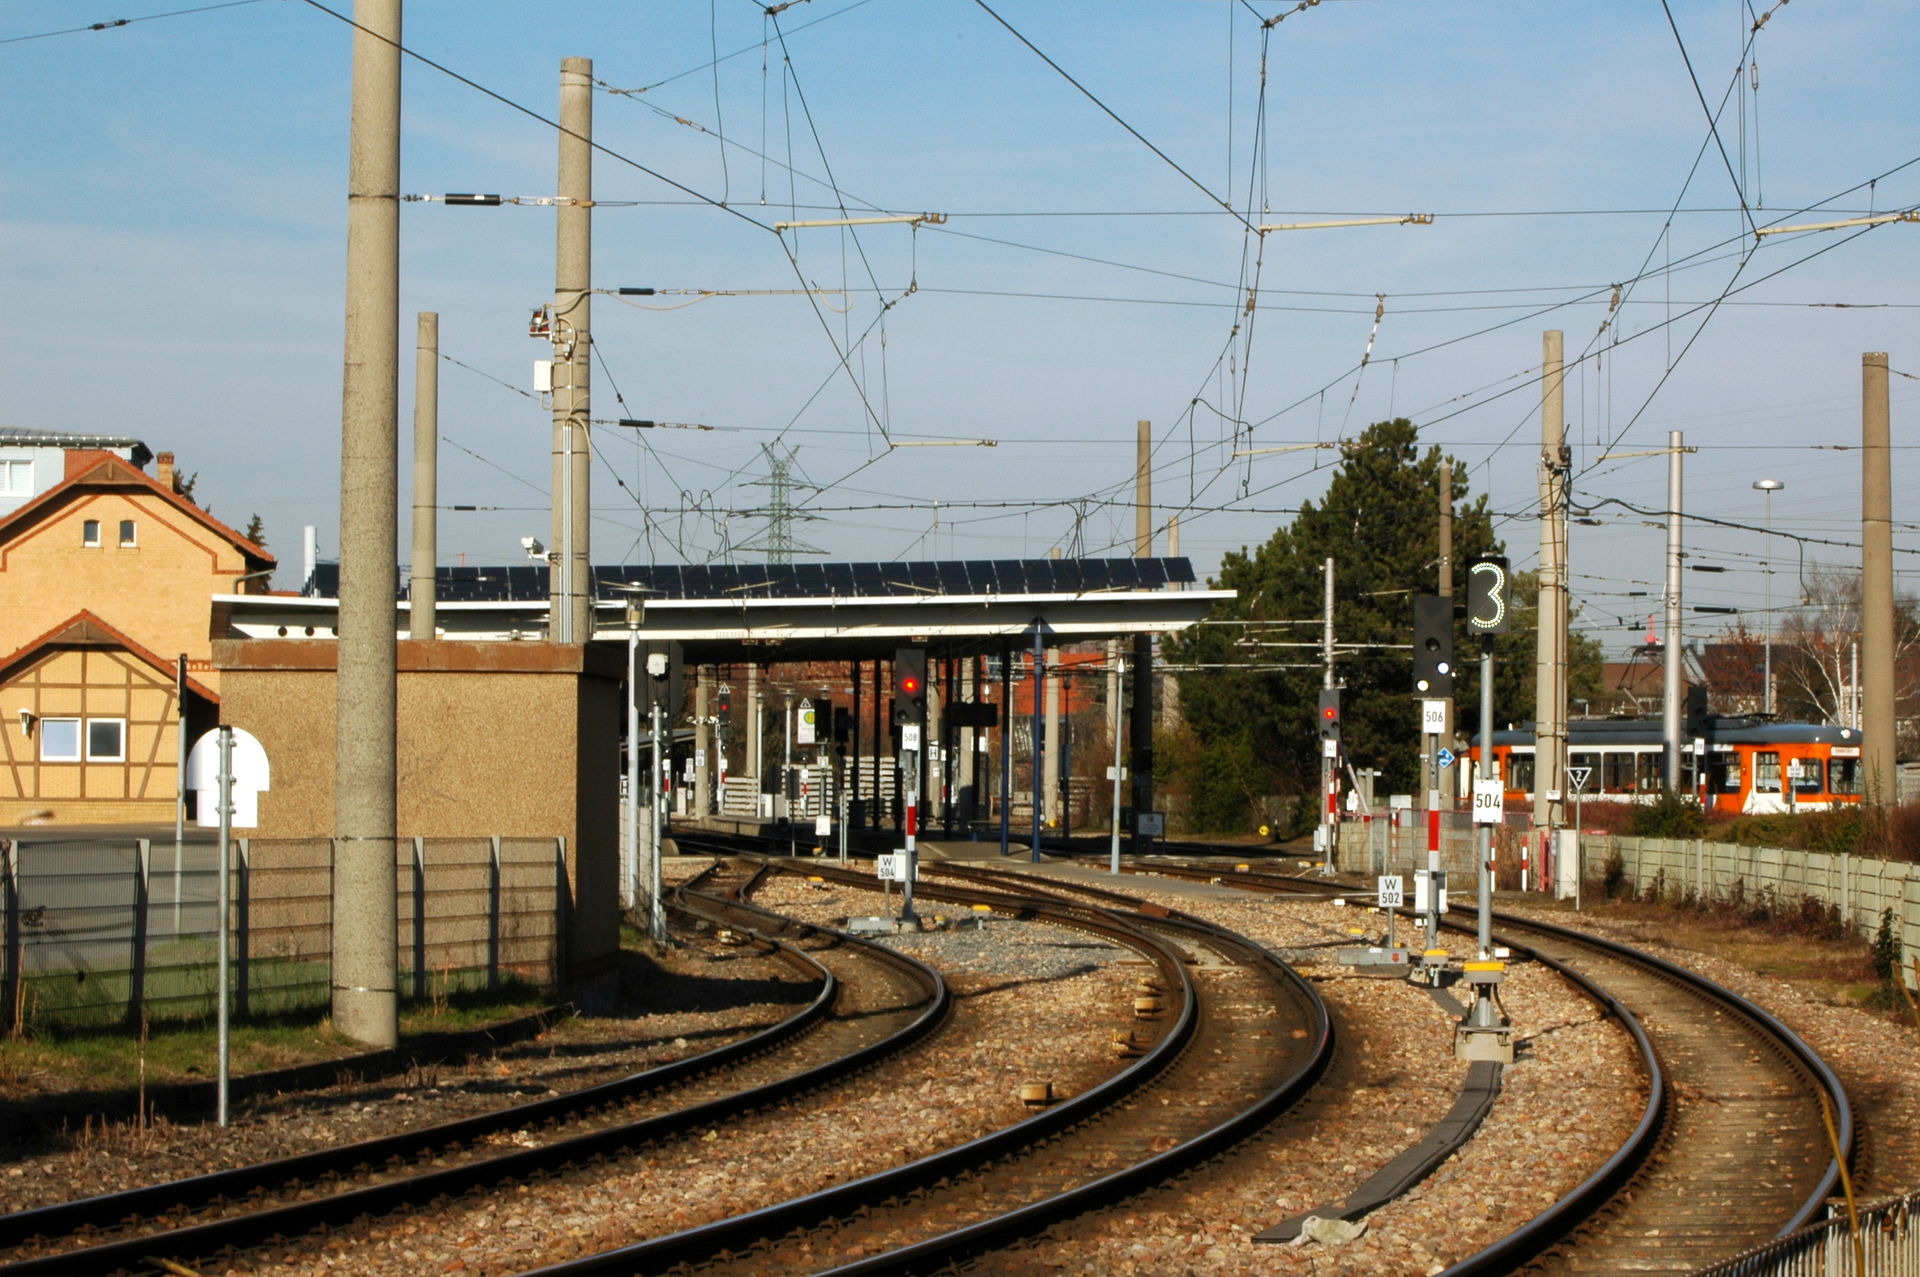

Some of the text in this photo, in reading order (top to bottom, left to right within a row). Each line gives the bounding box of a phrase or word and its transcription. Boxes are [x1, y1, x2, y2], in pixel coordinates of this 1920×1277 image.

[1471, 562, 1505, 628] 3
[1426, 711, 1443, 722] 506
[904, 733, 918, 742] 508
[930, 748, 937, 758] H
[1576, 770, 1582, 782] 2
[1476, 794, 1501, 808] 504
[882, 857, 893, 866] W
[880, 867, 895, 877] 504
[1384, 879, 1397, 890] W
[1382, 892, 1400, 904] 502
